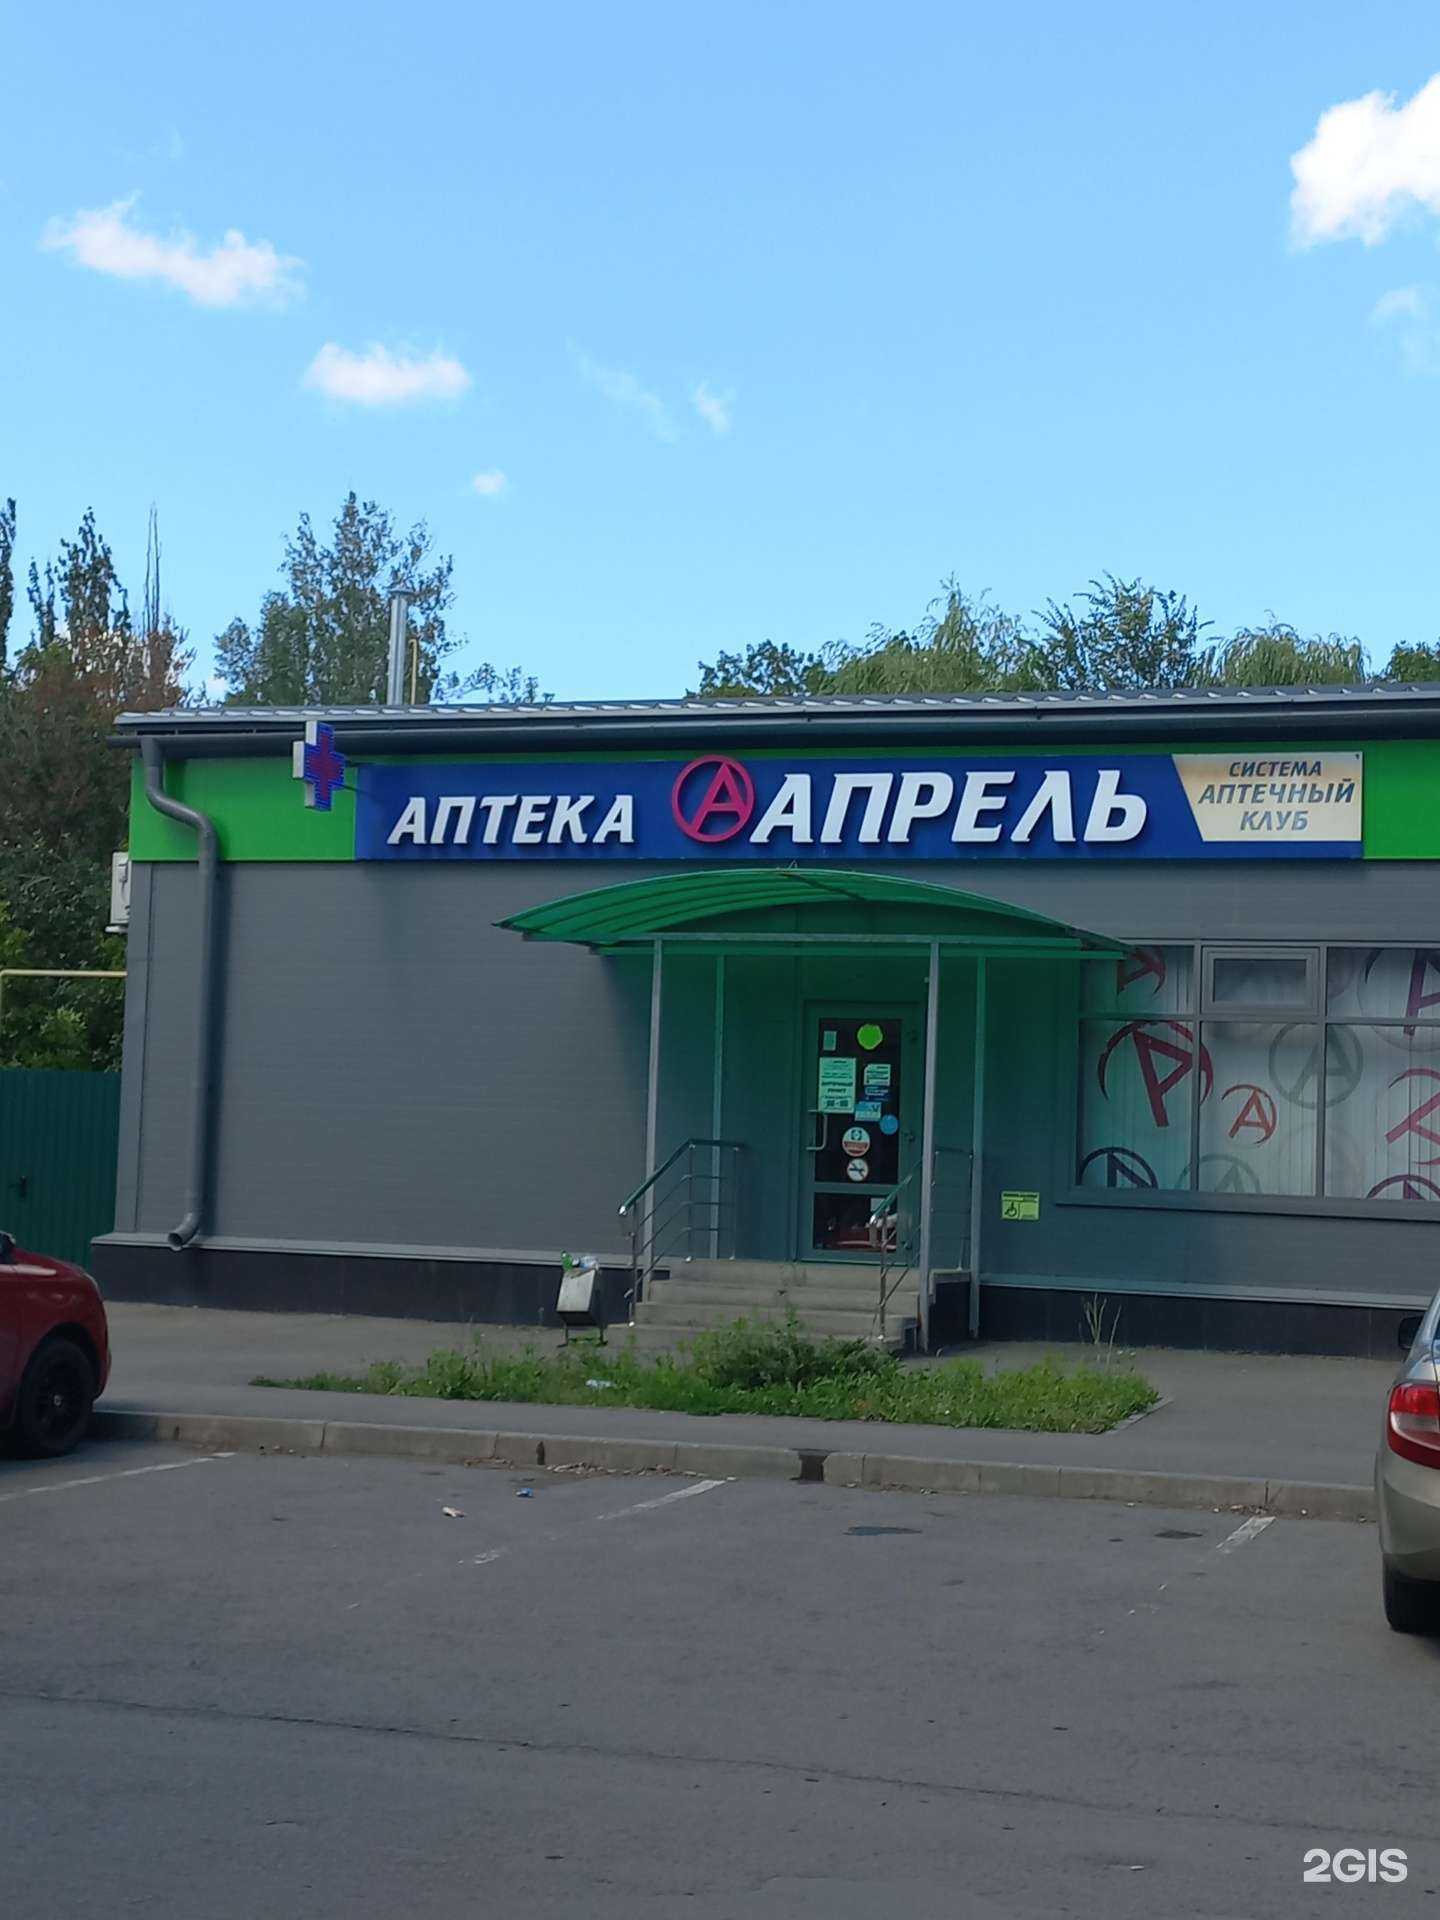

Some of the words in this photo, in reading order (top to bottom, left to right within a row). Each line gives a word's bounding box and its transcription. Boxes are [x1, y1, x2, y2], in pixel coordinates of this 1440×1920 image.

[1229, 760, 1322, 777] СИСТЕМА
[1198, 778, 1355, 804] АПТЕЧНЫЙ
[749, 769, 1148, 843] АПРЕЛЬ
[387, 794, 635, 845] АПТЕКА
[1240, 810, 1308, 831] КЛУБ
